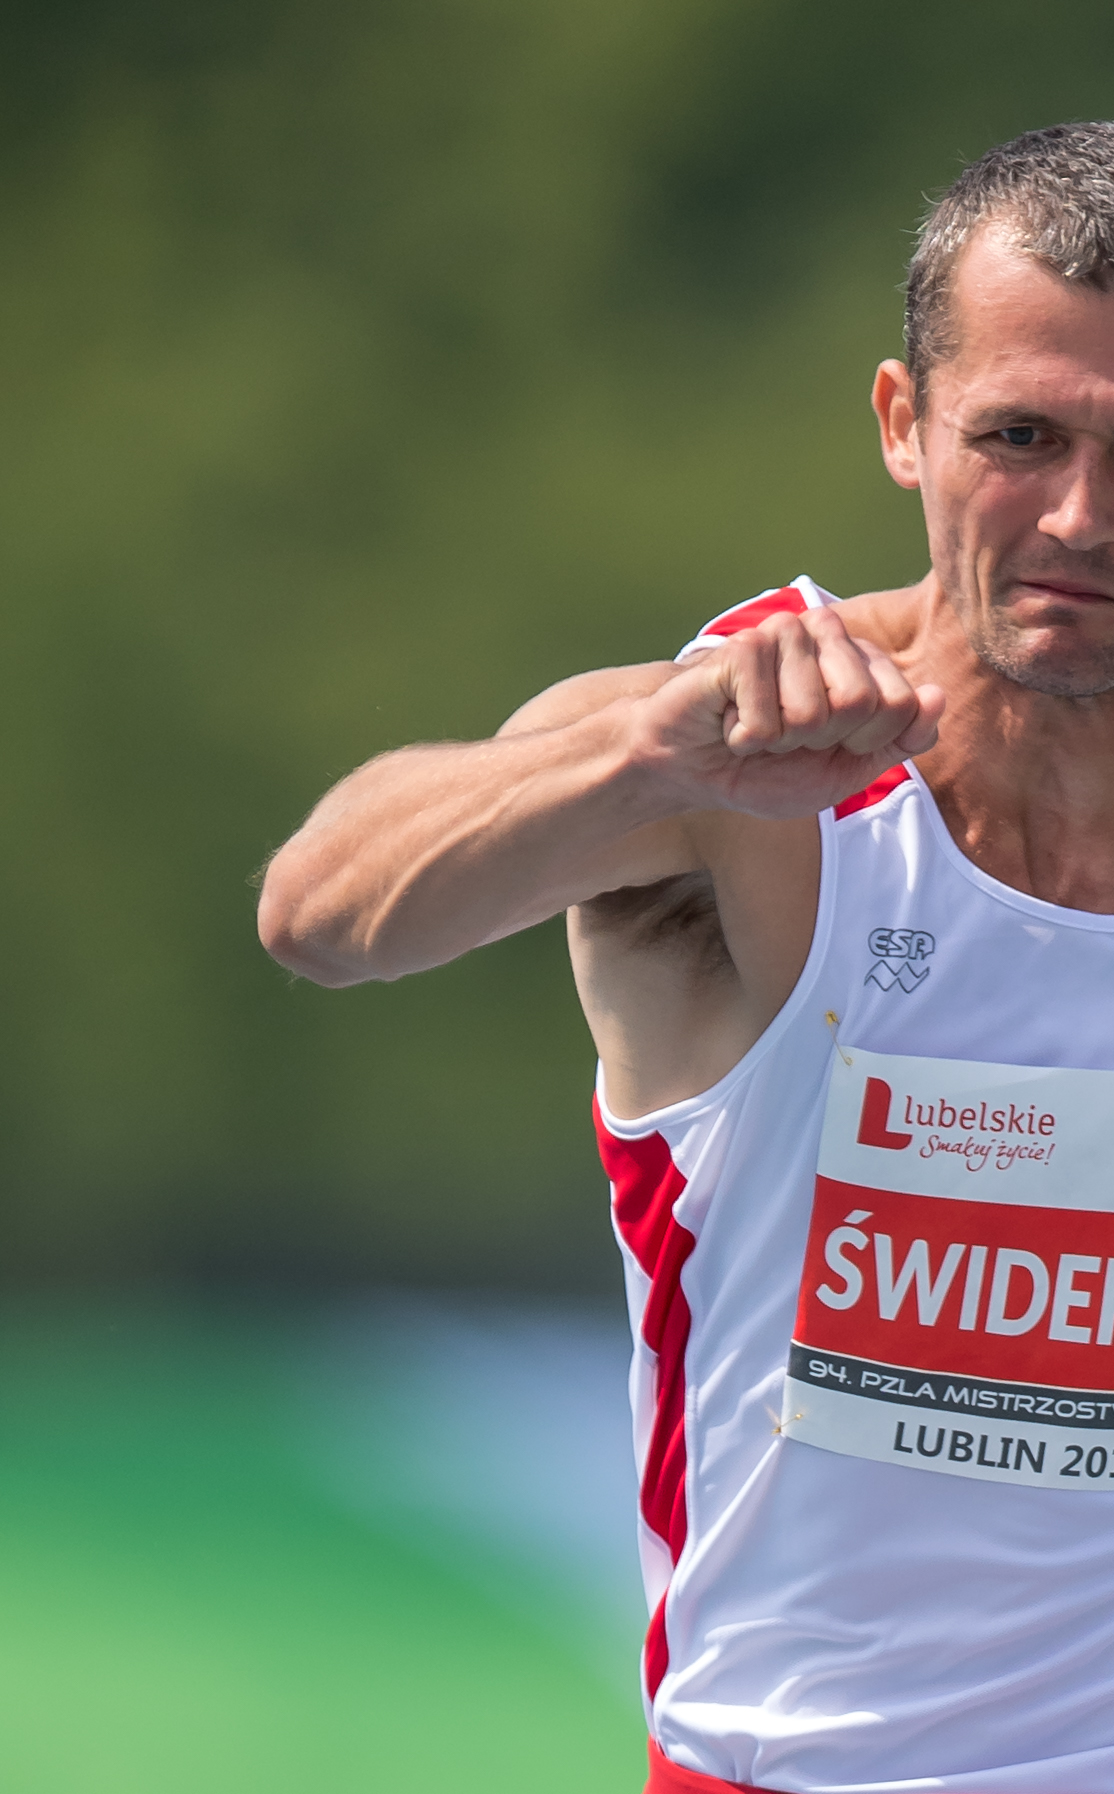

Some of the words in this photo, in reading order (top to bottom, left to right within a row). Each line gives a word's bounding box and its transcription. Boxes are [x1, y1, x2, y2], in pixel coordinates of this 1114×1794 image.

[904, 1095, 1055, 1136] lubelskie
[808, 1359, 852, 1385] 94.
[860, 1371, 936, 1400] PZLA
[893, 1421, 1047, 1474] LUBLIN
